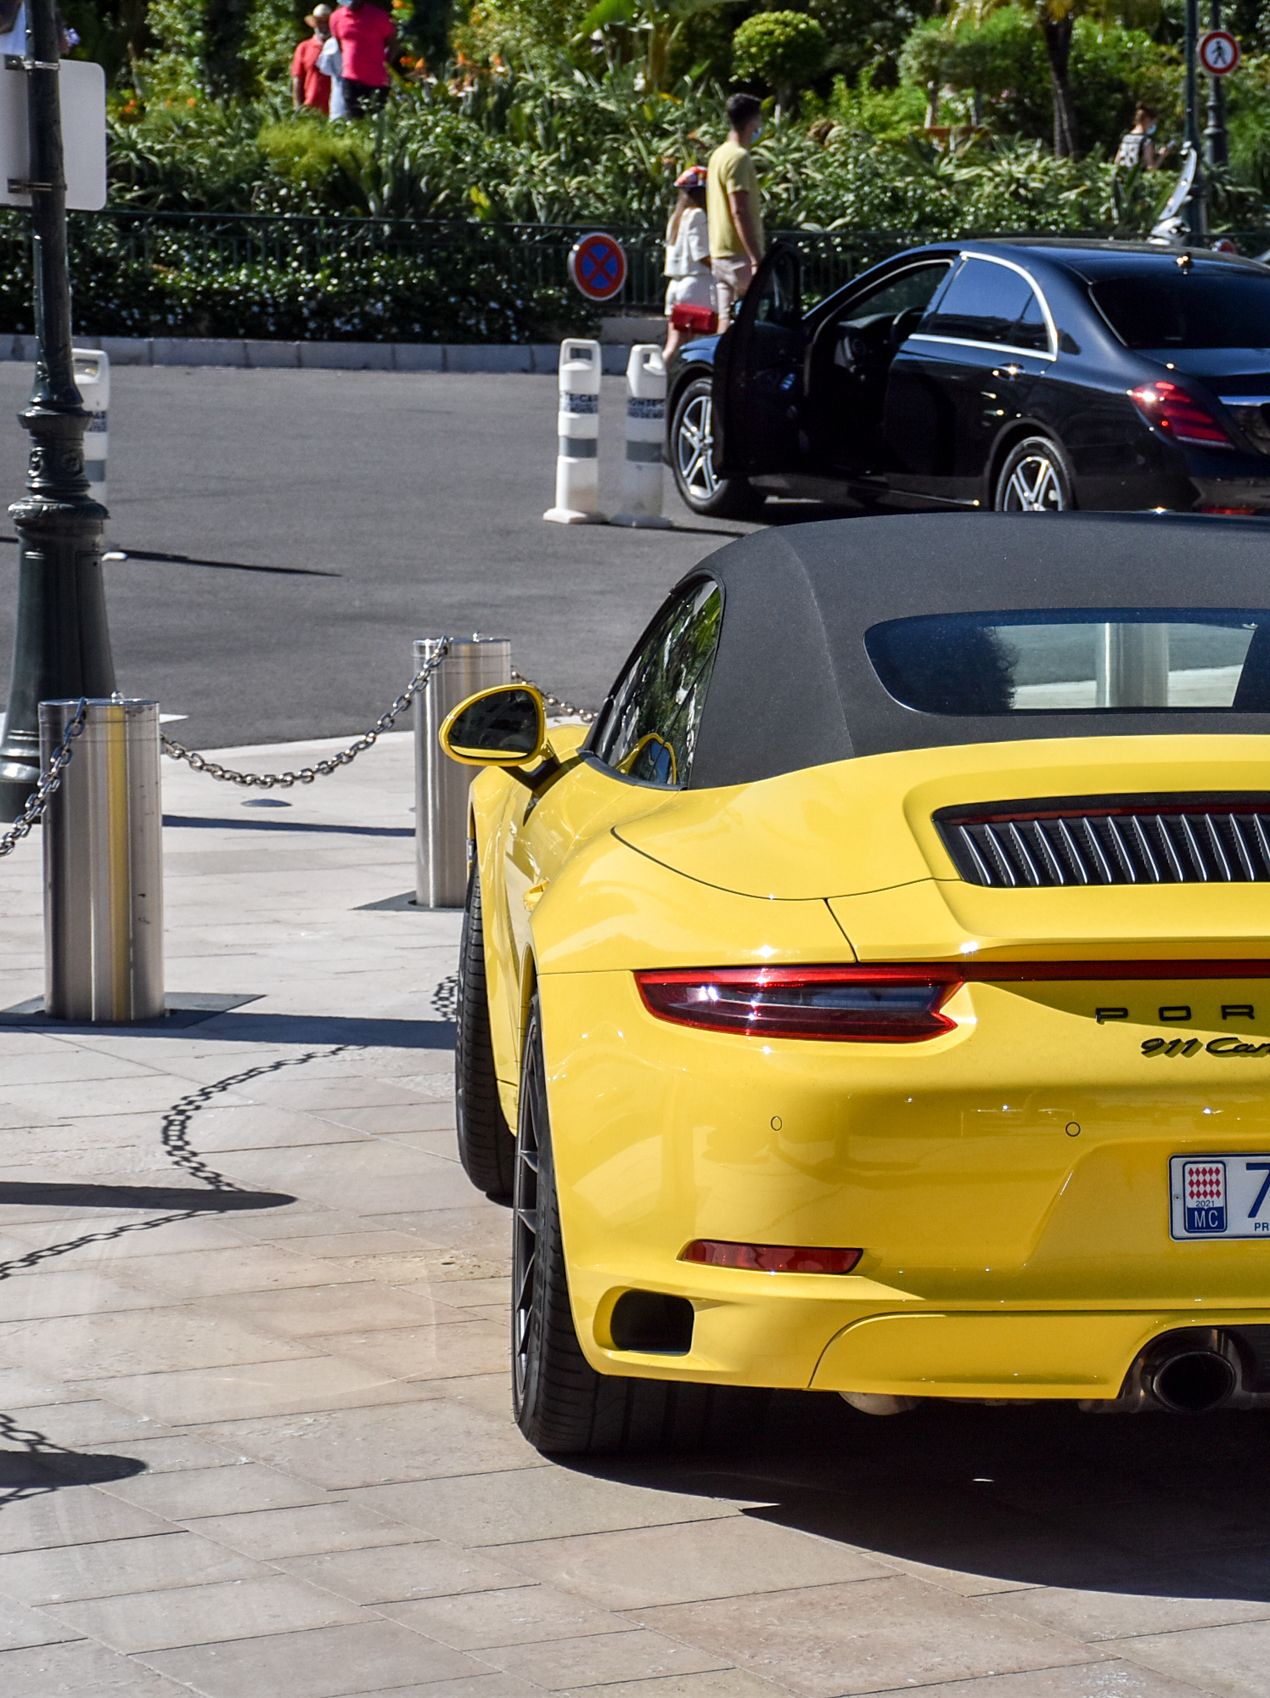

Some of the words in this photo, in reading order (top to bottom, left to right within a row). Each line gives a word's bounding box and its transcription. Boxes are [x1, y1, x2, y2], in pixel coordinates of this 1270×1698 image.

[1140, 1037, 1198, 1055] 911
[1195, 1199, 1215, 1207] 2021
[1194, 1211, 1219, 1228] MC
